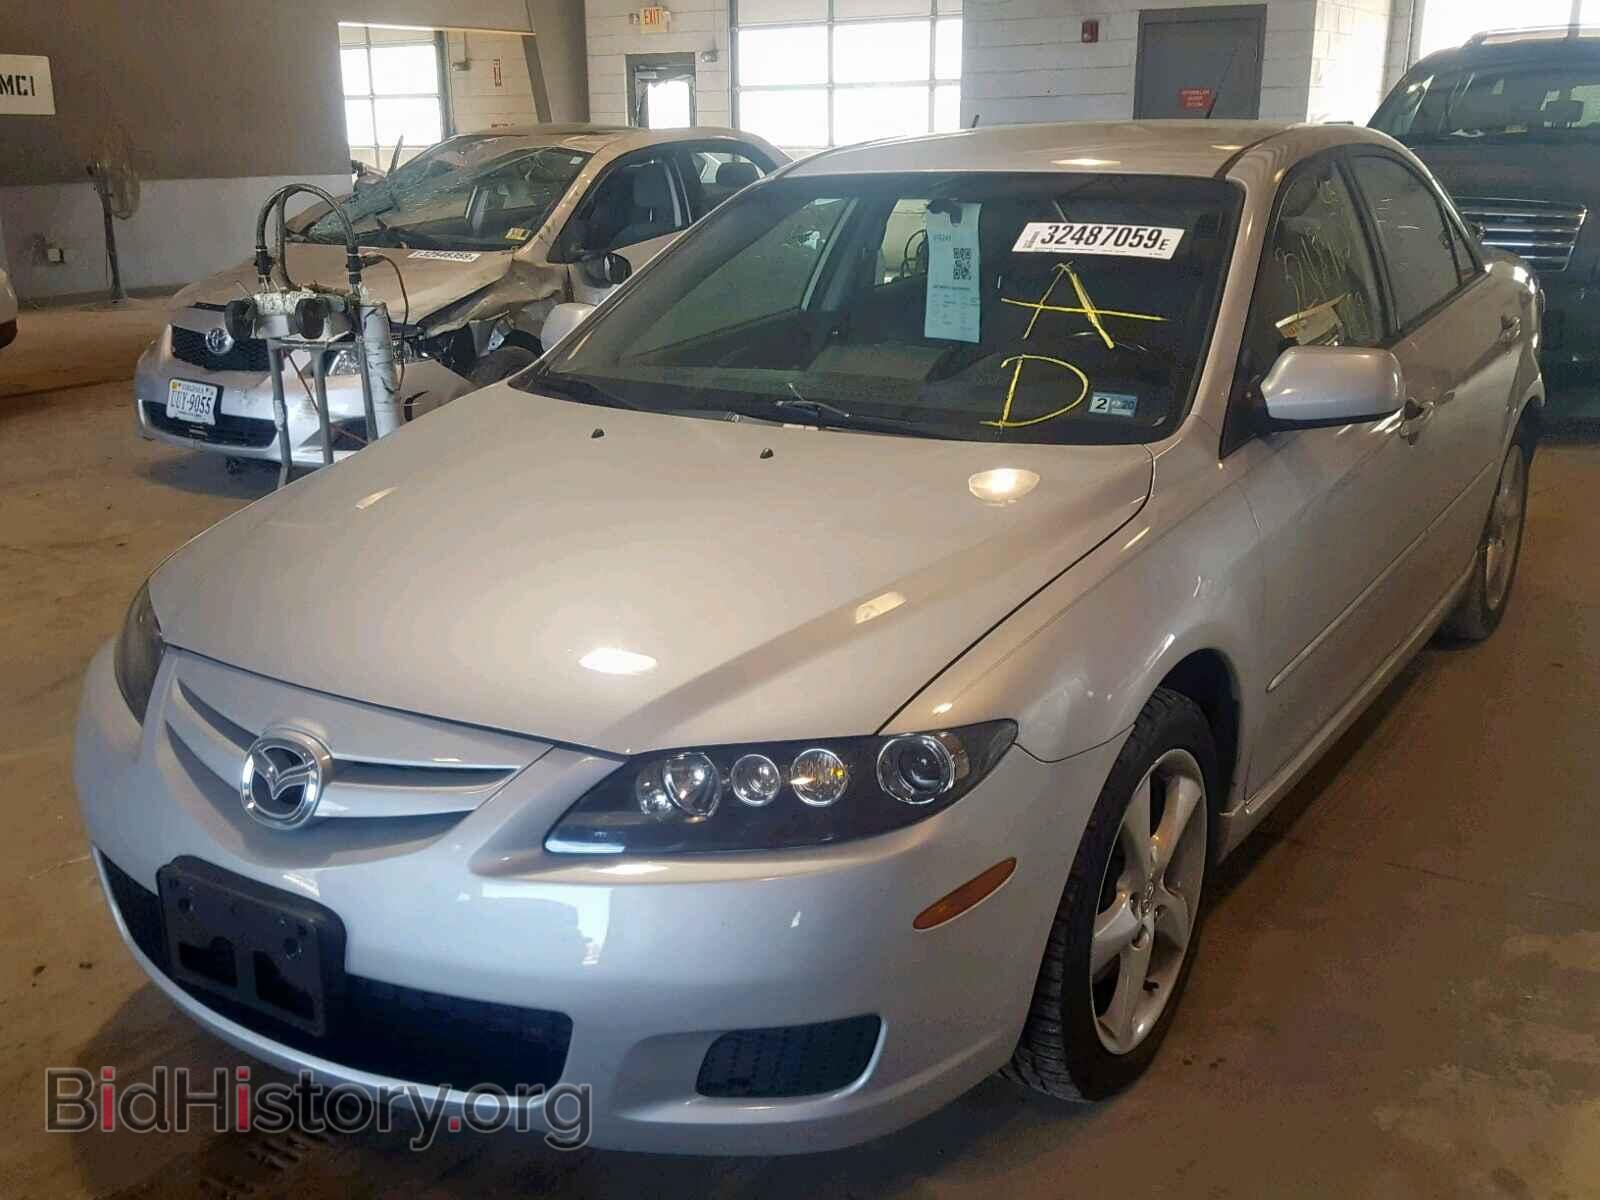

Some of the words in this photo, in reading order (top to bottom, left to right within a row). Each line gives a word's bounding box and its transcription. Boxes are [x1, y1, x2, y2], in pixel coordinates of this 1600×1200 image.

[643, 8, 661, 25] EXIT
[1041, 225, 1163, 249] 32487059
[1159, 238, 1171, 251] E
[1001, 260, 1168, 349] A
[980, 354, 1089, 428] D
[1096, 398, 1108, 410] 2
